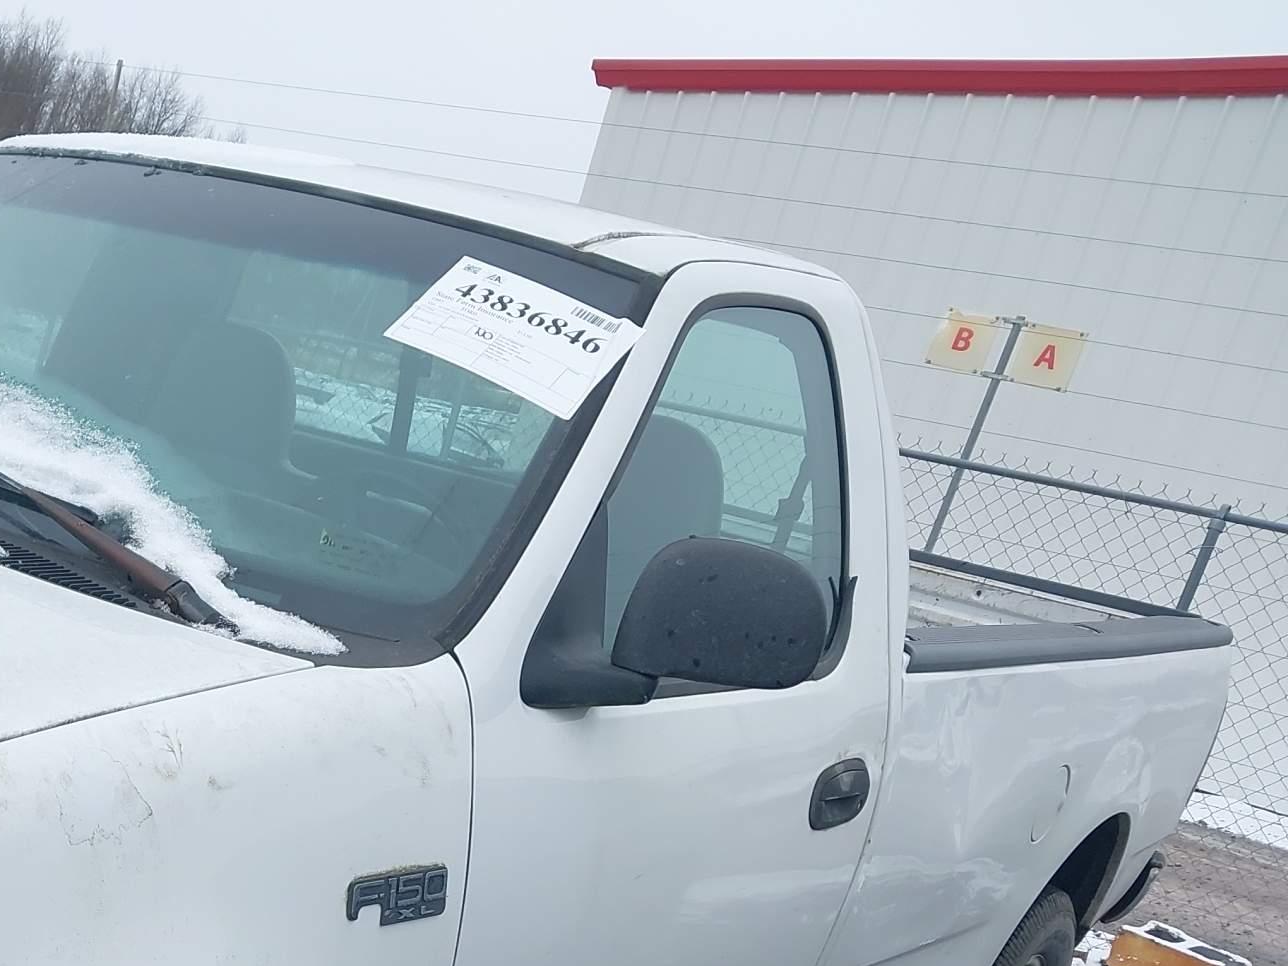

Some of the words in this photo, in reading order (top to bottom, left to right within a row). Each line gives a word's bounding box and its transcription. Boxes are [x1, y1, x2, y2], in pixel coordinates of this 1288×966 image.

[455, 283, 608, 354] 43836846
[951, 326, 974, 352] B
[1032, 344, 1056, 370] A
